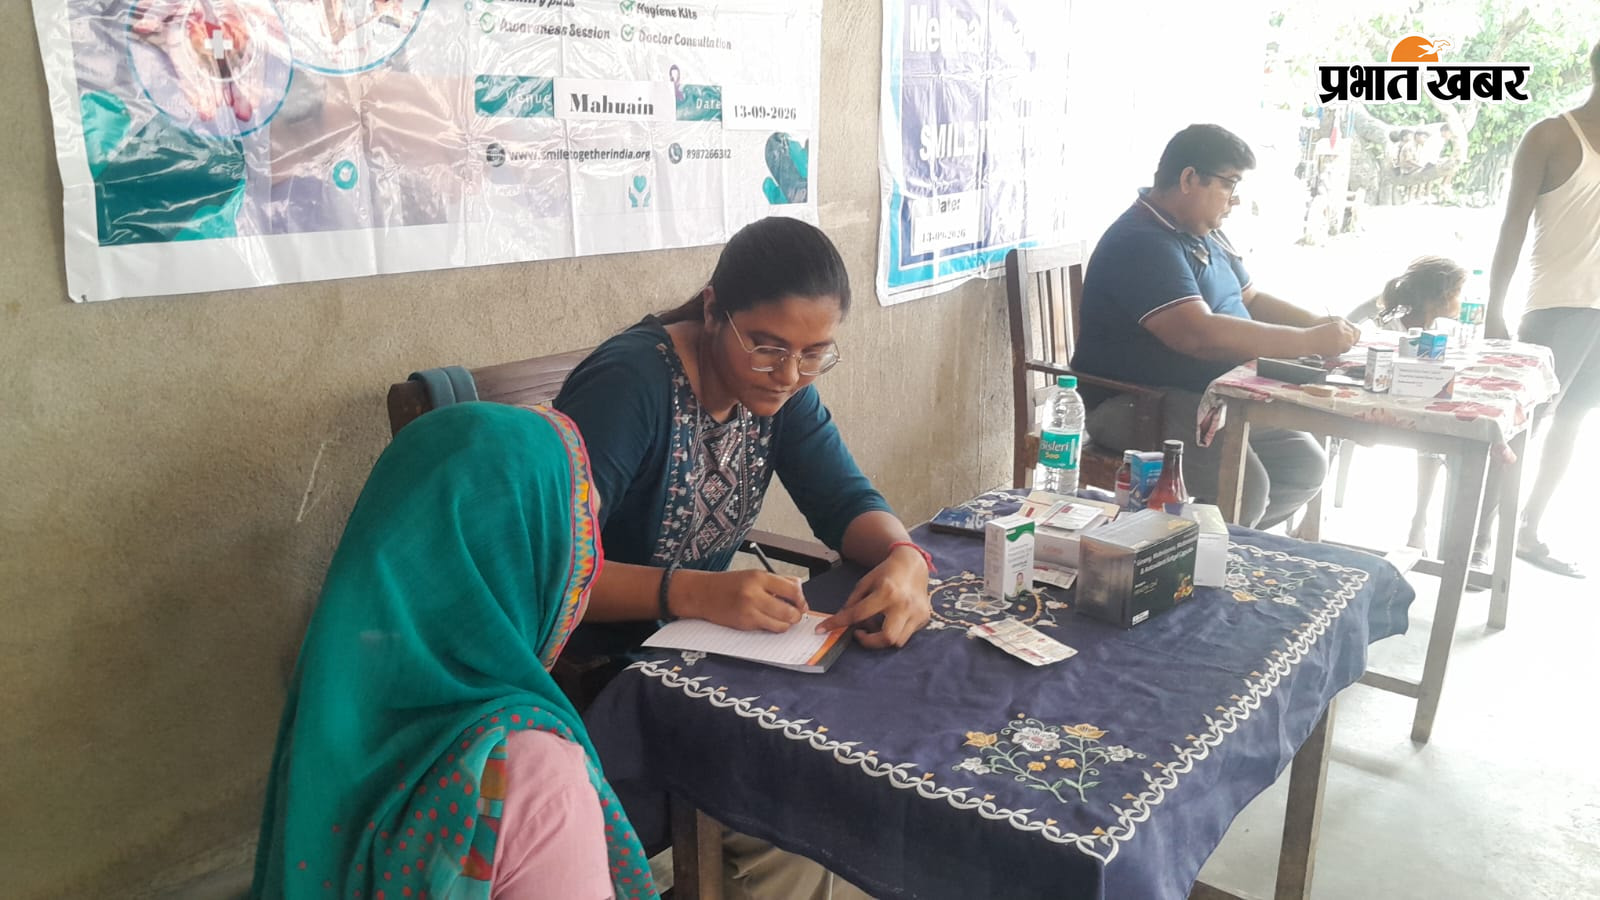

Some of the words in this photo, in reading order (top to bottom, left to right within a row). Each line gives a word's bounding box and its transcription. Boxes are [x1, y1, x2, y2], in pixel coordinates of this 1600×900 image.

[637, 2, 677, 18] Hygiene
[678, 7, 698, 20] Kits
[569, 23, 610, 39] Session
[639, 29, 672, 45] Doctor
[674, 33, 732, 50] Consultation
[570, 93, 654, 116] Mahuain
[696, 98, 721, 110] Date
[734, 104, 797, 121] 13-09-2026
[509, 148, 651, 161] www.smiletogetherindia.org
